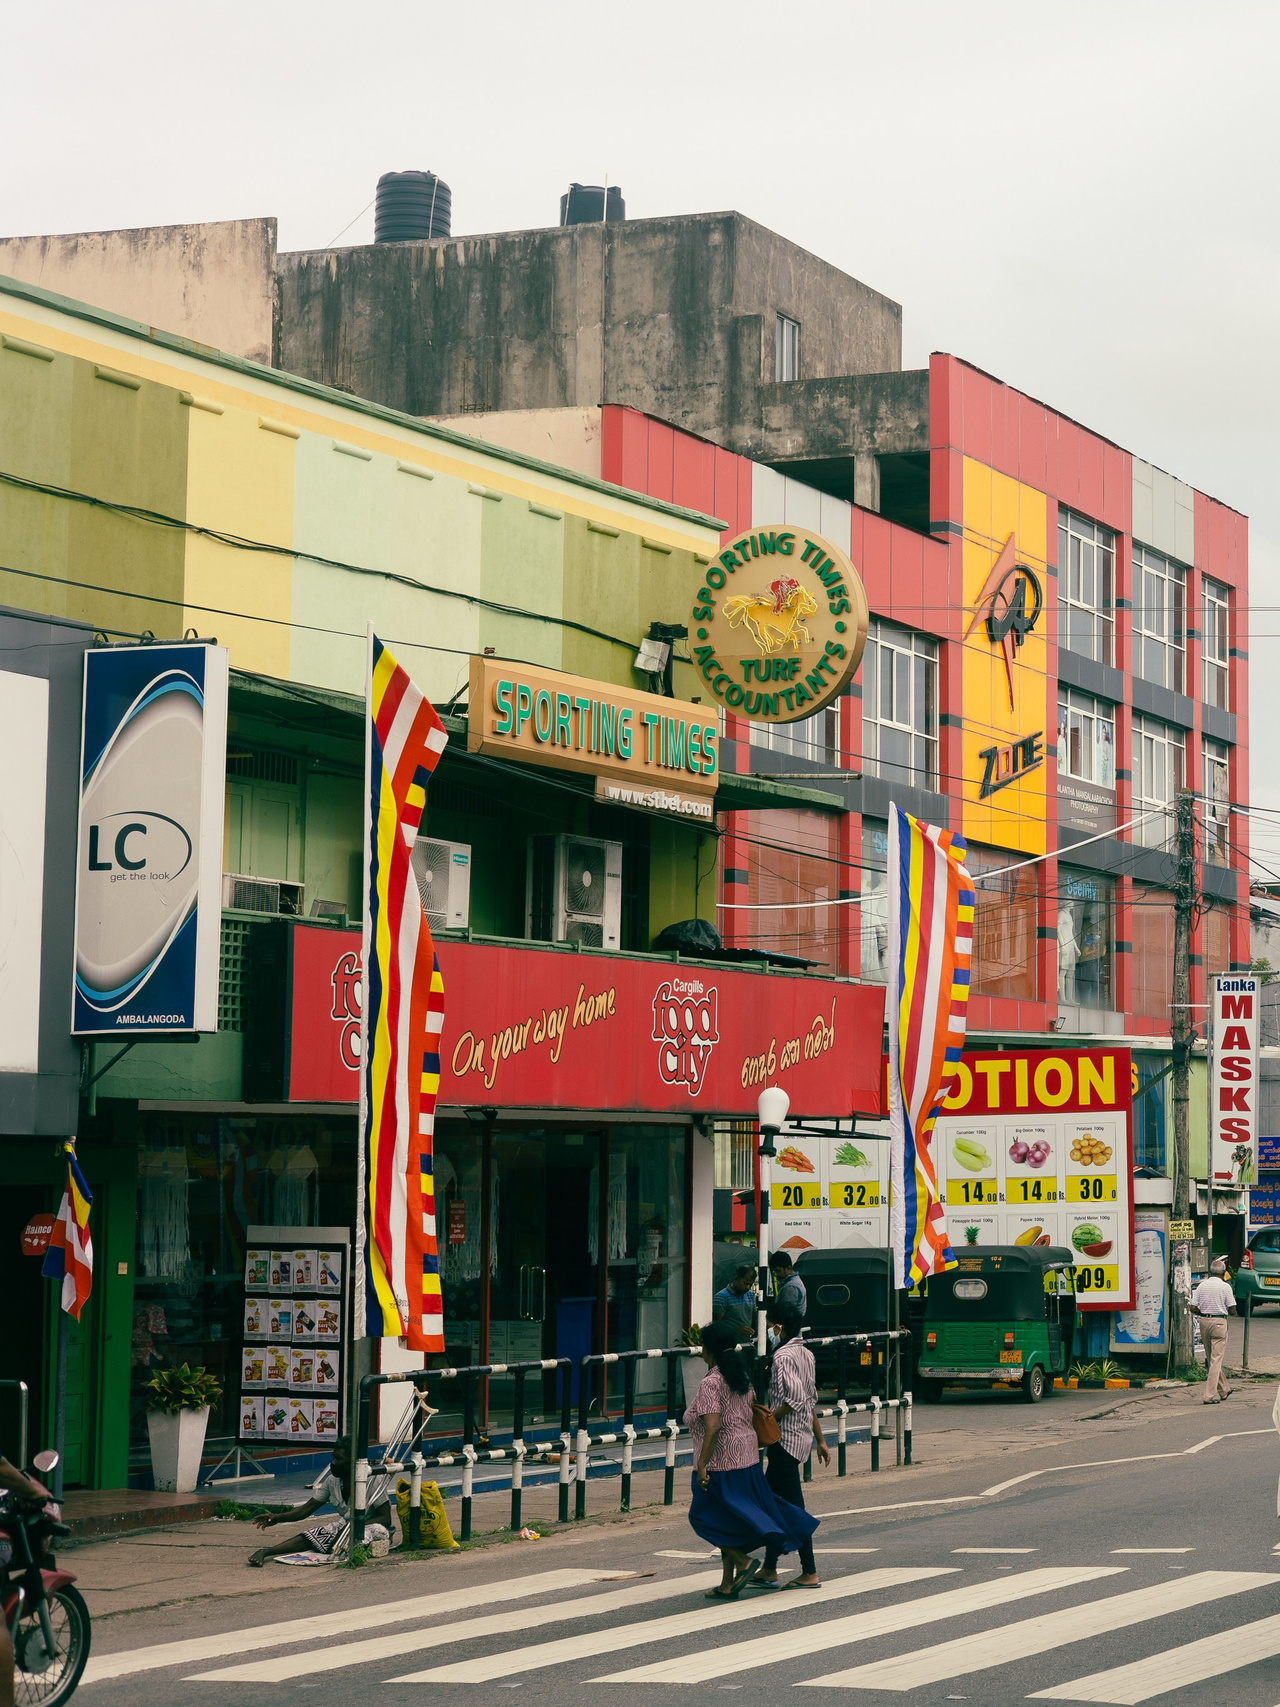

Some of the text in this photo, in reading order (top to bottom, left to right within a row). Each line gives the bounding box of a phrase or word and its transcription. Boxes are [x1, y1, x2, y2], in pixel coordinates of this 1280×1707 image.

[693, 531, 850, 621] SPORTING TIMES
[693, 640, 846, 715] ACCOUNTANTS
[739, 658, 802, 682] TURF
[492, 680, 717, 775] SPORTING TIMES
[979, 731, 1043, 799] ZONE
[604, 786, 712, 817] www.stbet.com
[89, 823, 148, 872] LC
[110, 871, 170, 882] get the look
[1066, 876, 1097, 900] Seemly
[673, 978, 704, 995] Cargills
[1216, 979, 1256, 992] Lanka
[116, 1014, 186, 1025] AMBALANGODA
[453, 983, 616, 1090] On your way home
[652, 982, 720, 1042] food
[659, 1039, 712, 1097] City
[1220, 995, 1252, 1142] MASKS
[25, 1226, 52, 1234] Rainco
